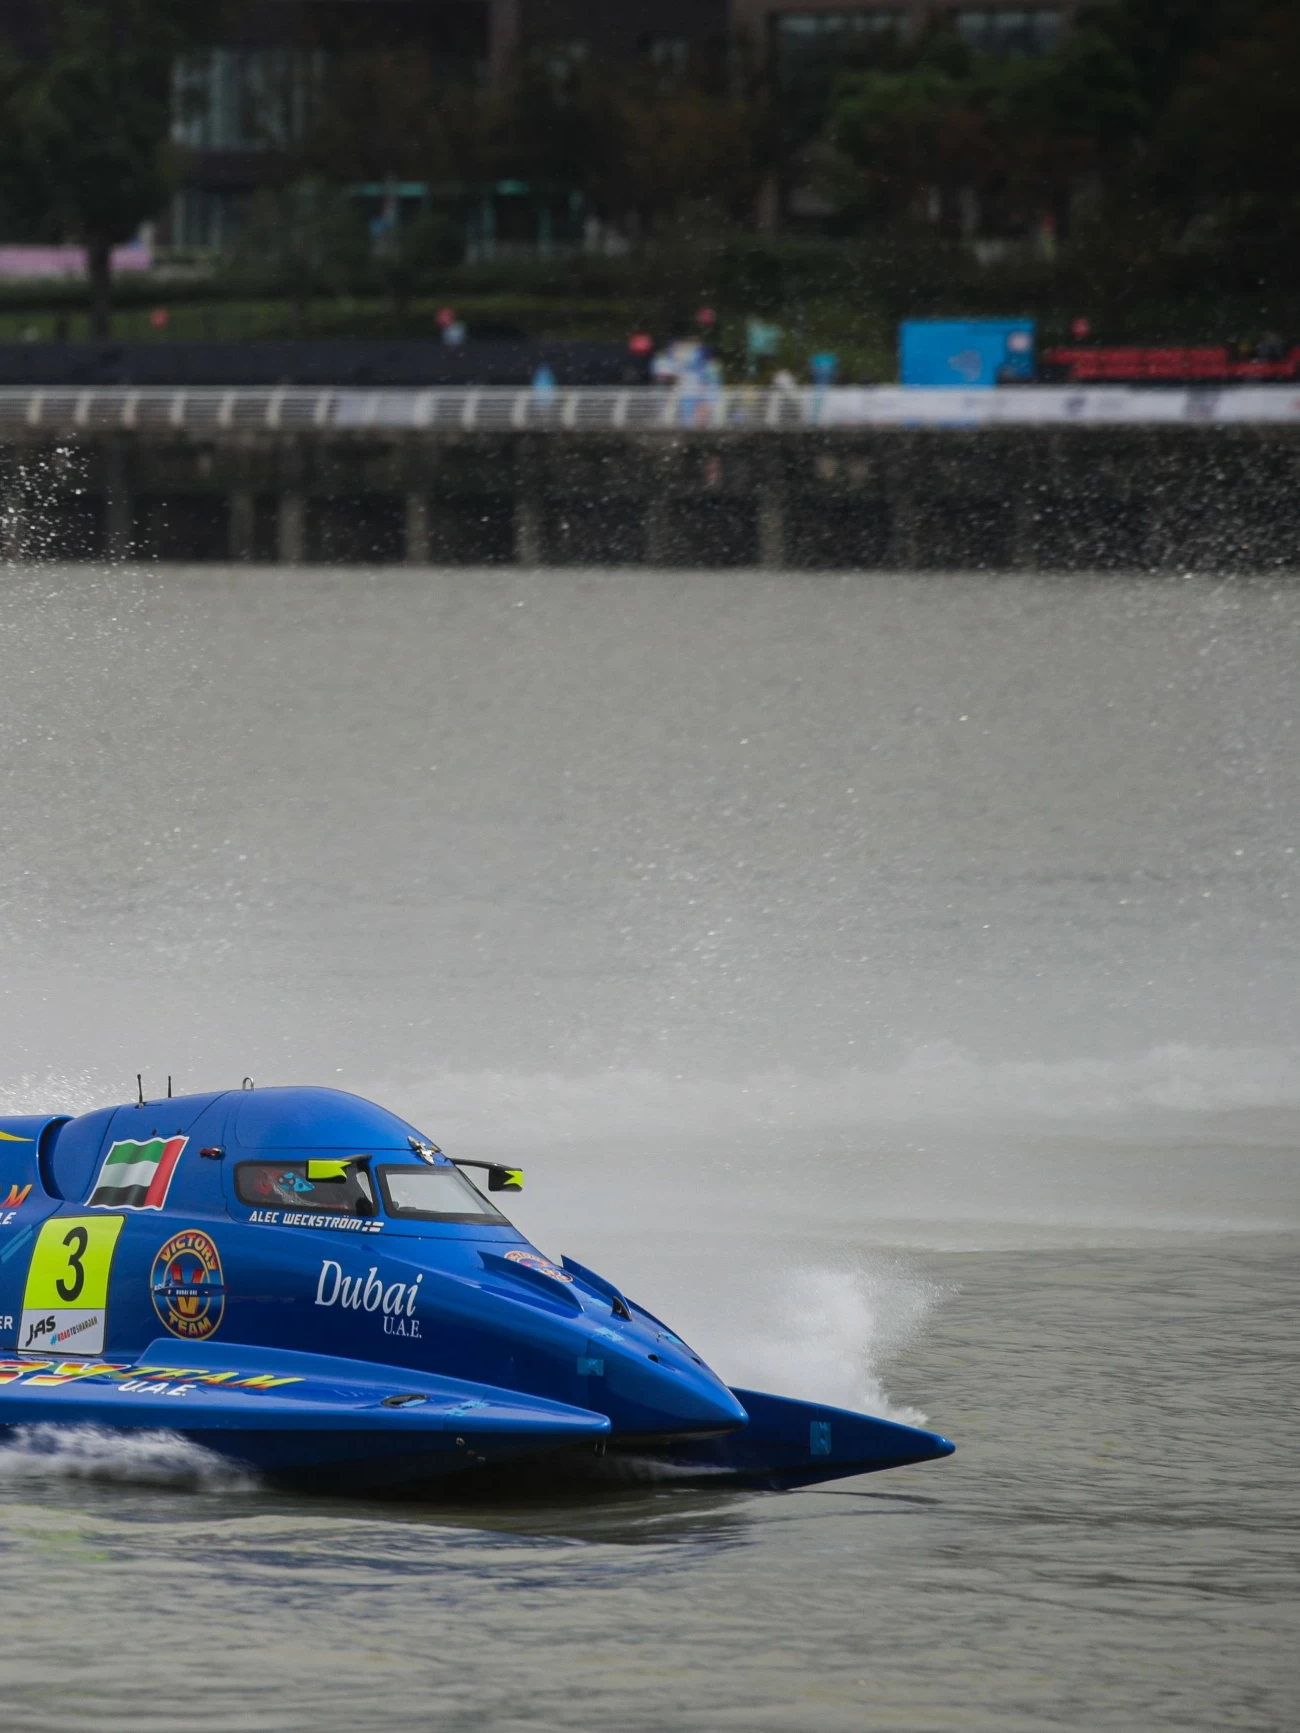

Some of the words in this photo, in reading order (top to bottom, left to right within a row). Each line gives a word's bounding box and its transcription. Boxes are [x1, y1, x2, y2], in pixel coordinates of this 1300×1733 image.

[249, 1210, 280, 1224] ALEC
[282, 1212, 364, 1231] WECKSTRÖM
[55, 1226, 89, 1302] 3
[160, 1231, 219, 1271] VICTORY
[314, 1259, 424, 1317] Dubai
[25, 1314, 57, 1348] JAS
[168, 1310, 213, 1336] TEAM
[383, 1315, 422, 1339] U.A.E.
[117, 1380, 198, 1397] U.A.E.
[118, 1365, 306, 1390] TEAM
